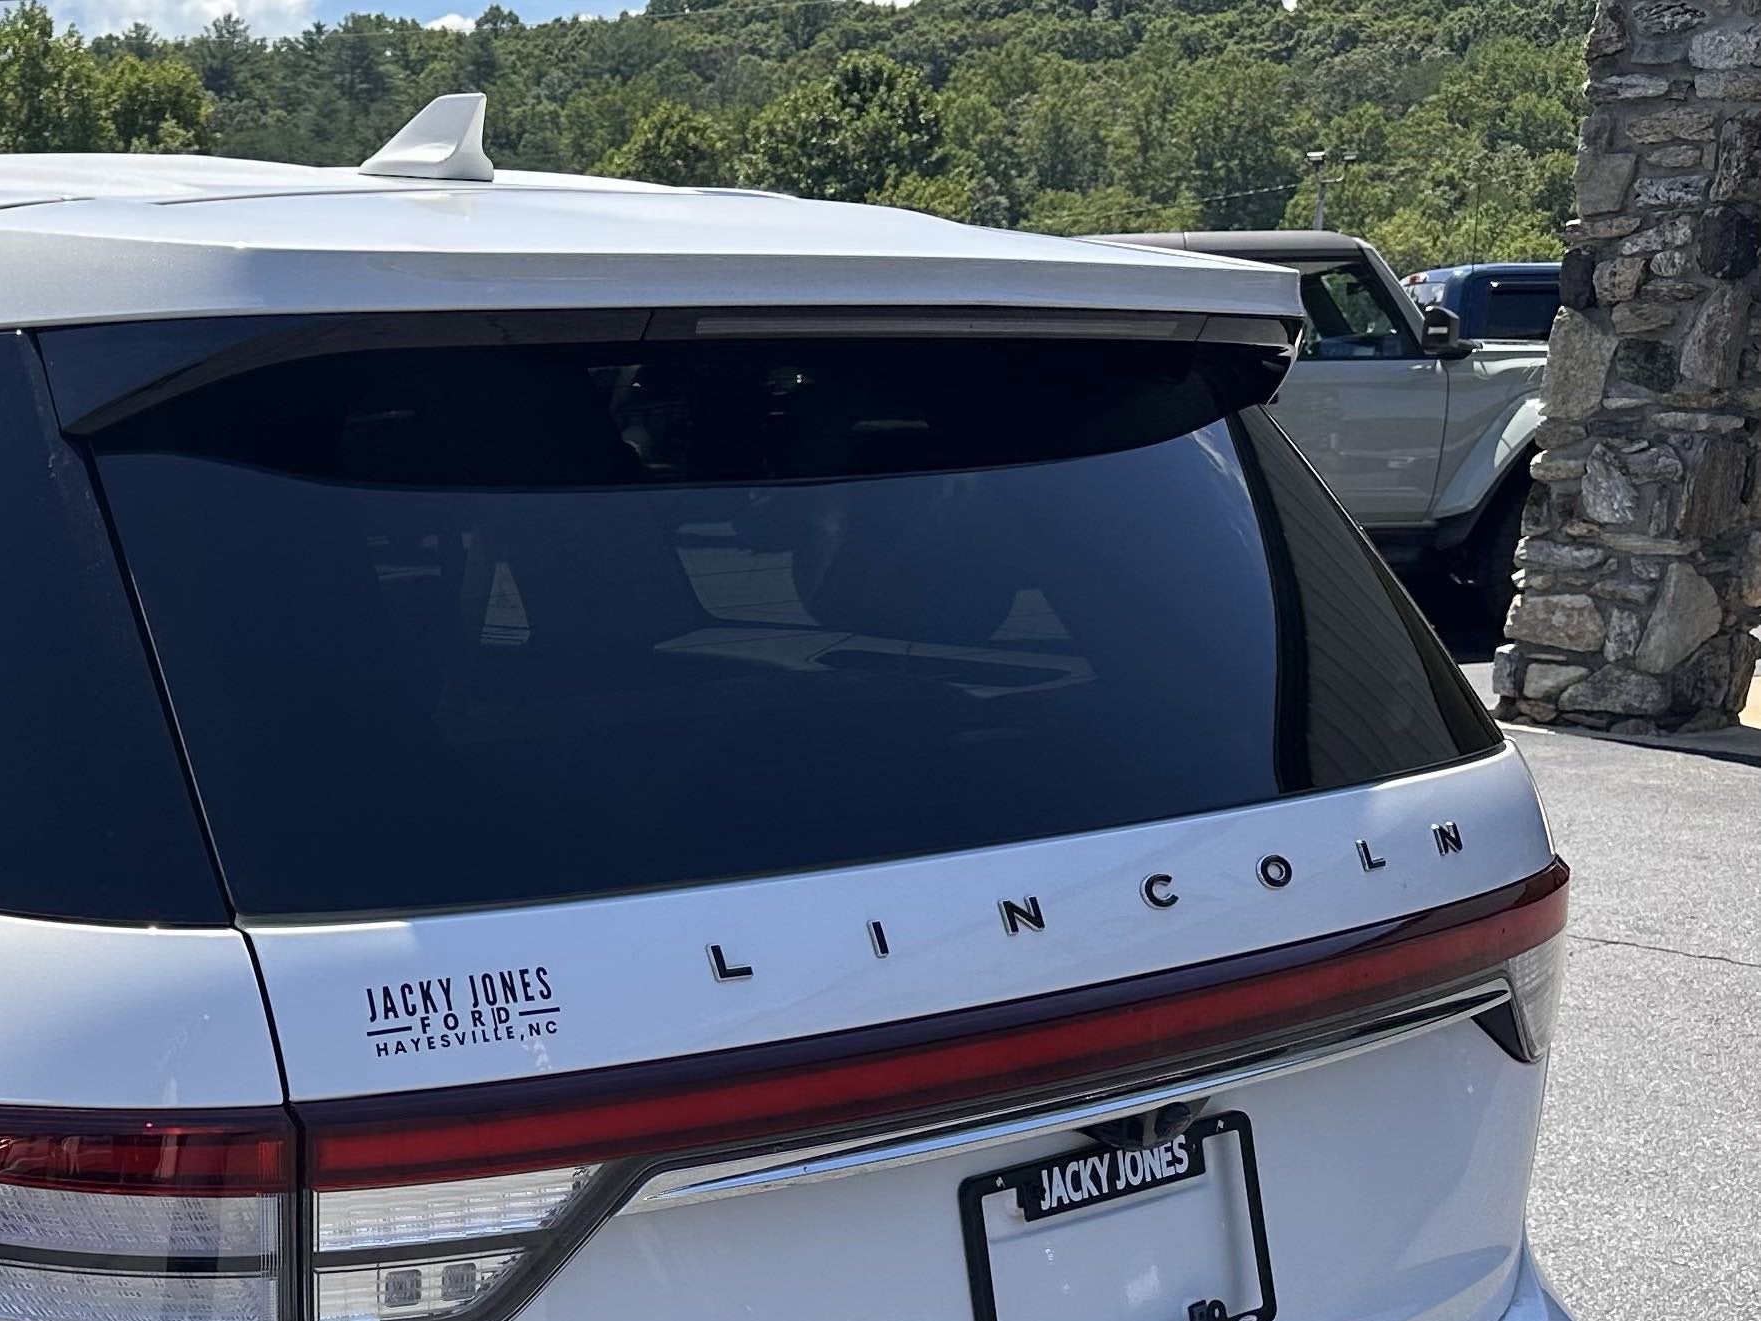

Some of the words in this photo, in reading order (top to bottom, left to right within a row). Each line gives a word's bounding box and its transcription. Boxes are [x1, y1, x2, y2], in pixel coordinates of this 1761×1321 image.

[706, 820, 1463, 982] LINCOLN
[366, 977, 451, 1023] JACKY
[469, 966, 552, 1008] JONES
[420, 1006, 510, 1034] FORD
[1040, 1152, 1110, 1211] JACKY
[1115, 1134, 1189, 1190] JONES
